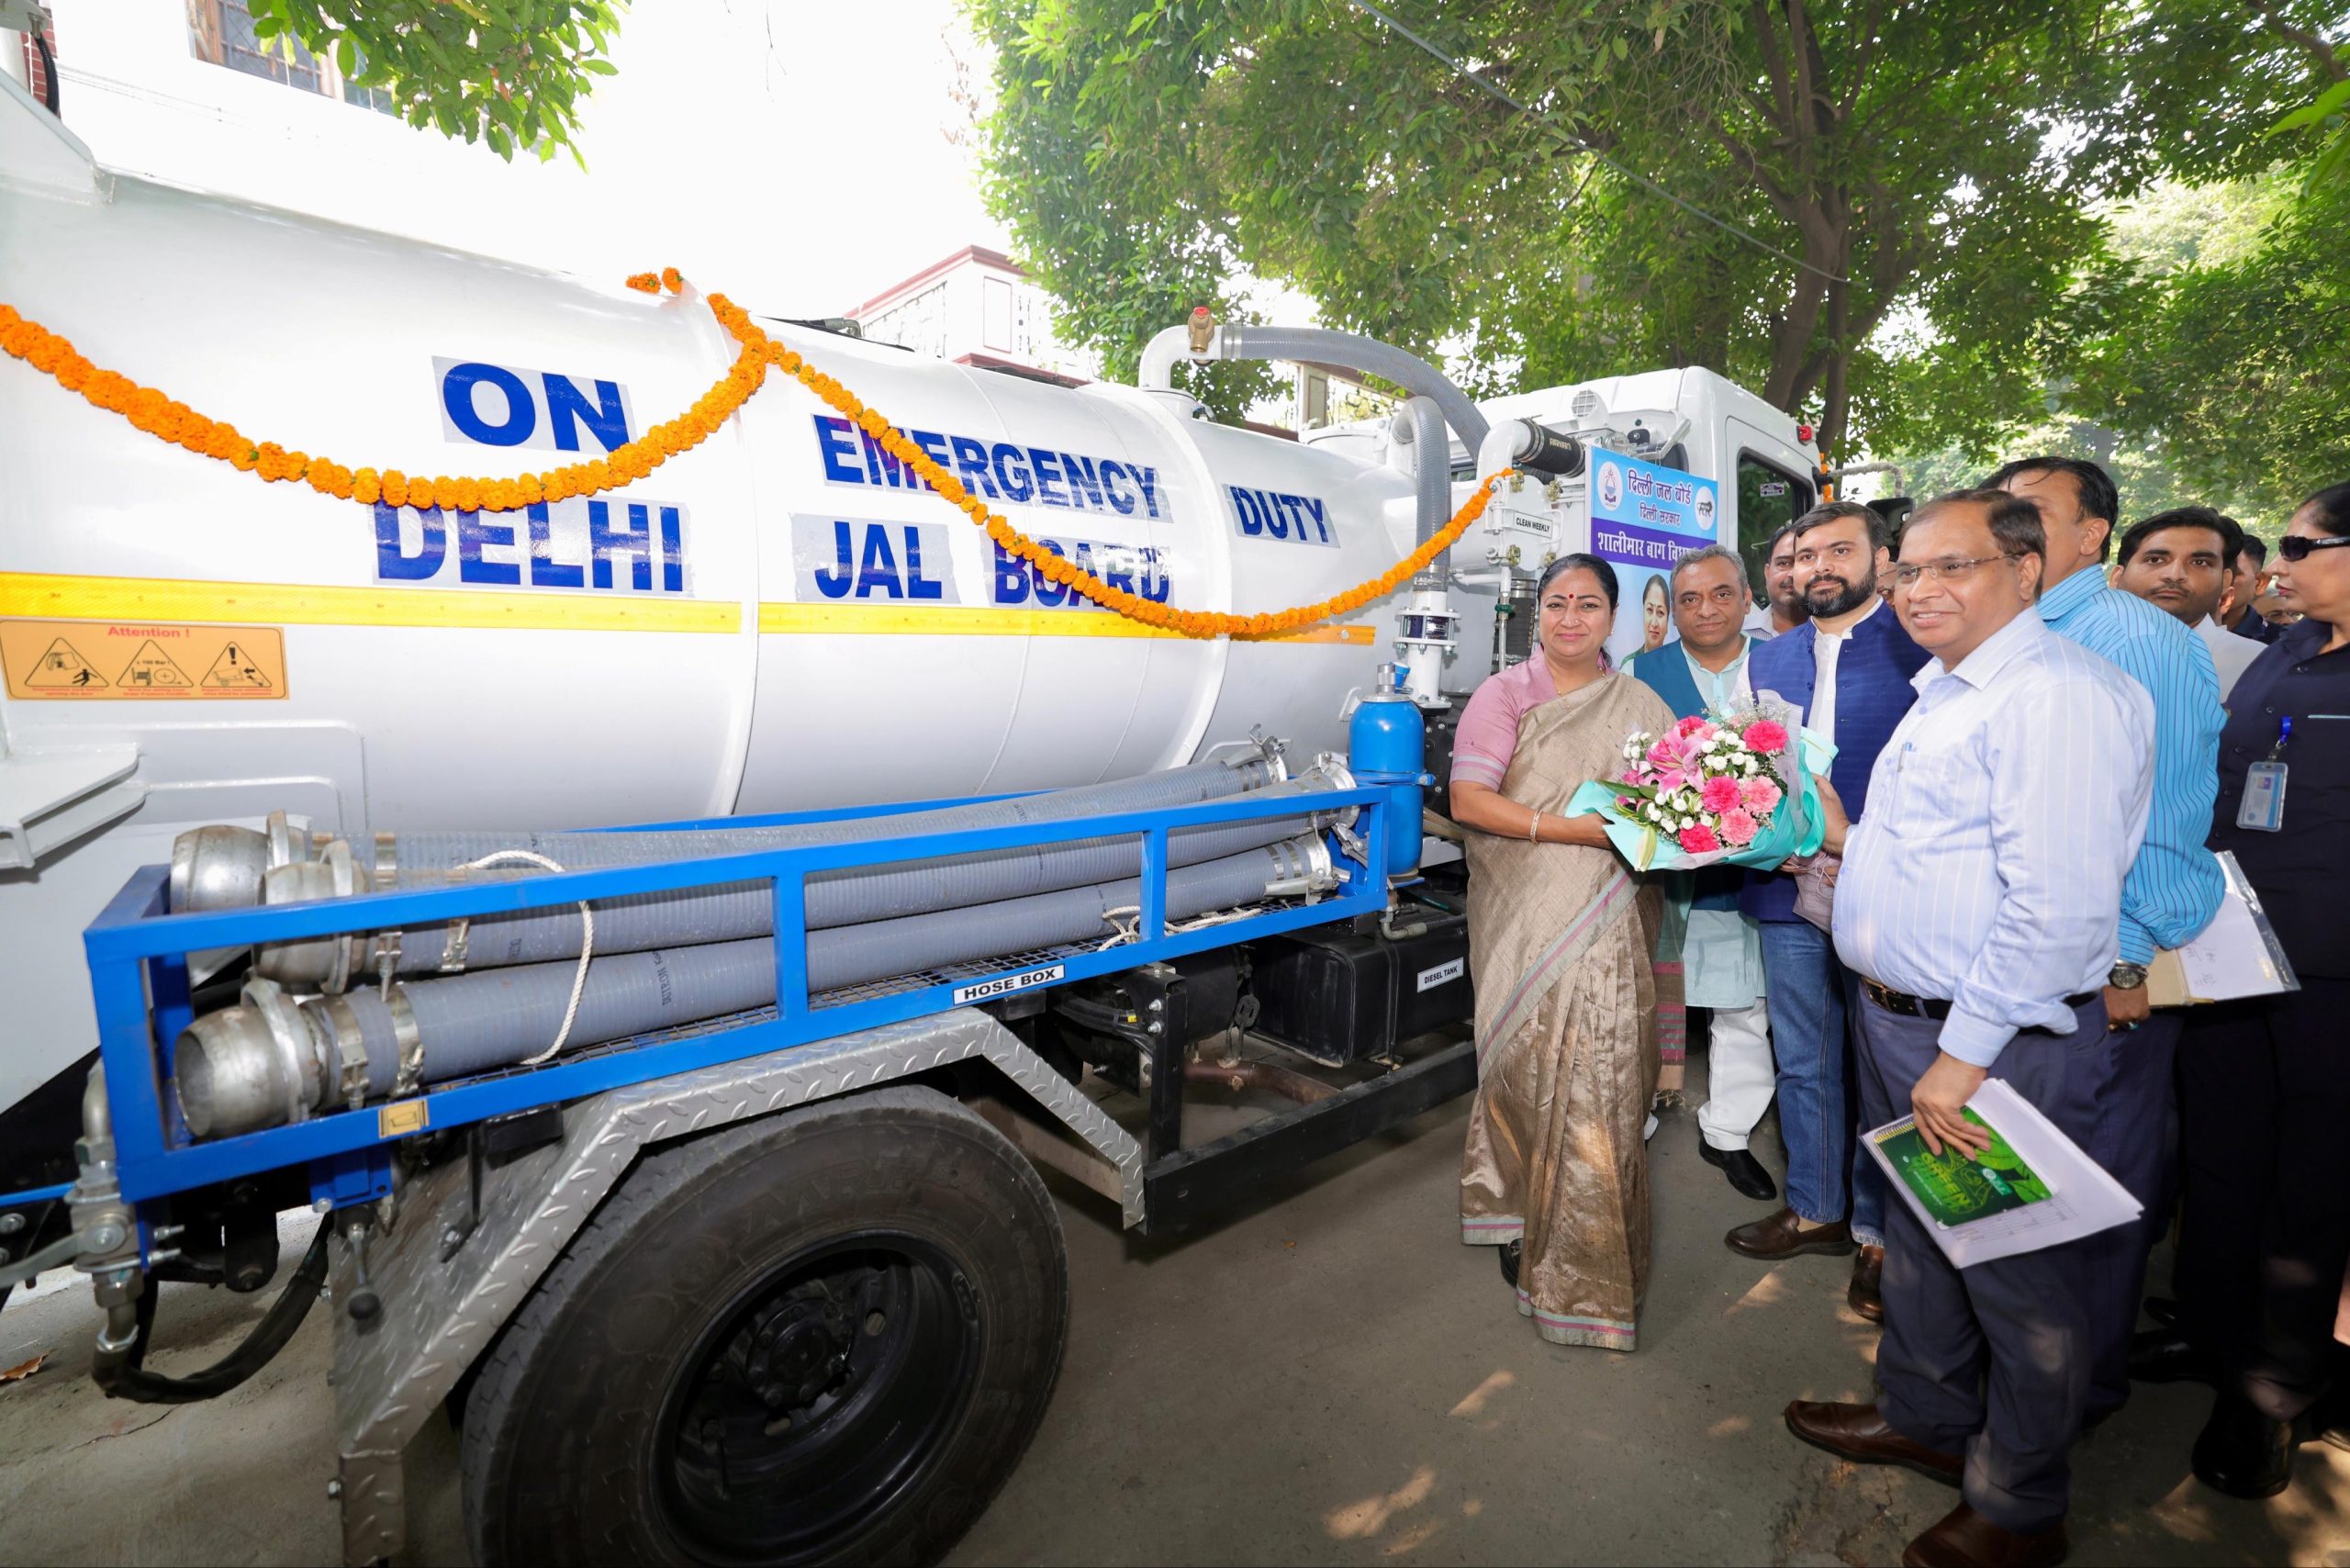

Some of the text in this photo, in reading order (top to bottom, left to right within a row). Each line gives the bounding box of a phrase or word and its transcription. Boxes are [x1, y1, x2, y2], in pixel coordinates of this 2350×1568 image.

[442, 363, 631, 453] ON
[813, 415, 1160, 518] EMERGENCY
[1628, 470, 1691, 504] दिल्ली जल बोर्ड
[1230, 487, 1328, 543] DUTY
[1516, 517, 1550, 532] CLEAN WEEKLY
[1639, 502, 1681, 526] दिल्ली सरकार
[374, 497, 683, 592] DELHI
[1598, 532, 1645, 556] शालीमार
[1647, 541, 1666, 559] बाग
[814, 521, 1169, 607] JAL BOARD
[107, 626, 181, 638] Attention
[964, 969, 1056, 1000] HOSE BOX
[1425, 966, 1458, 984] DIESEL TANK
